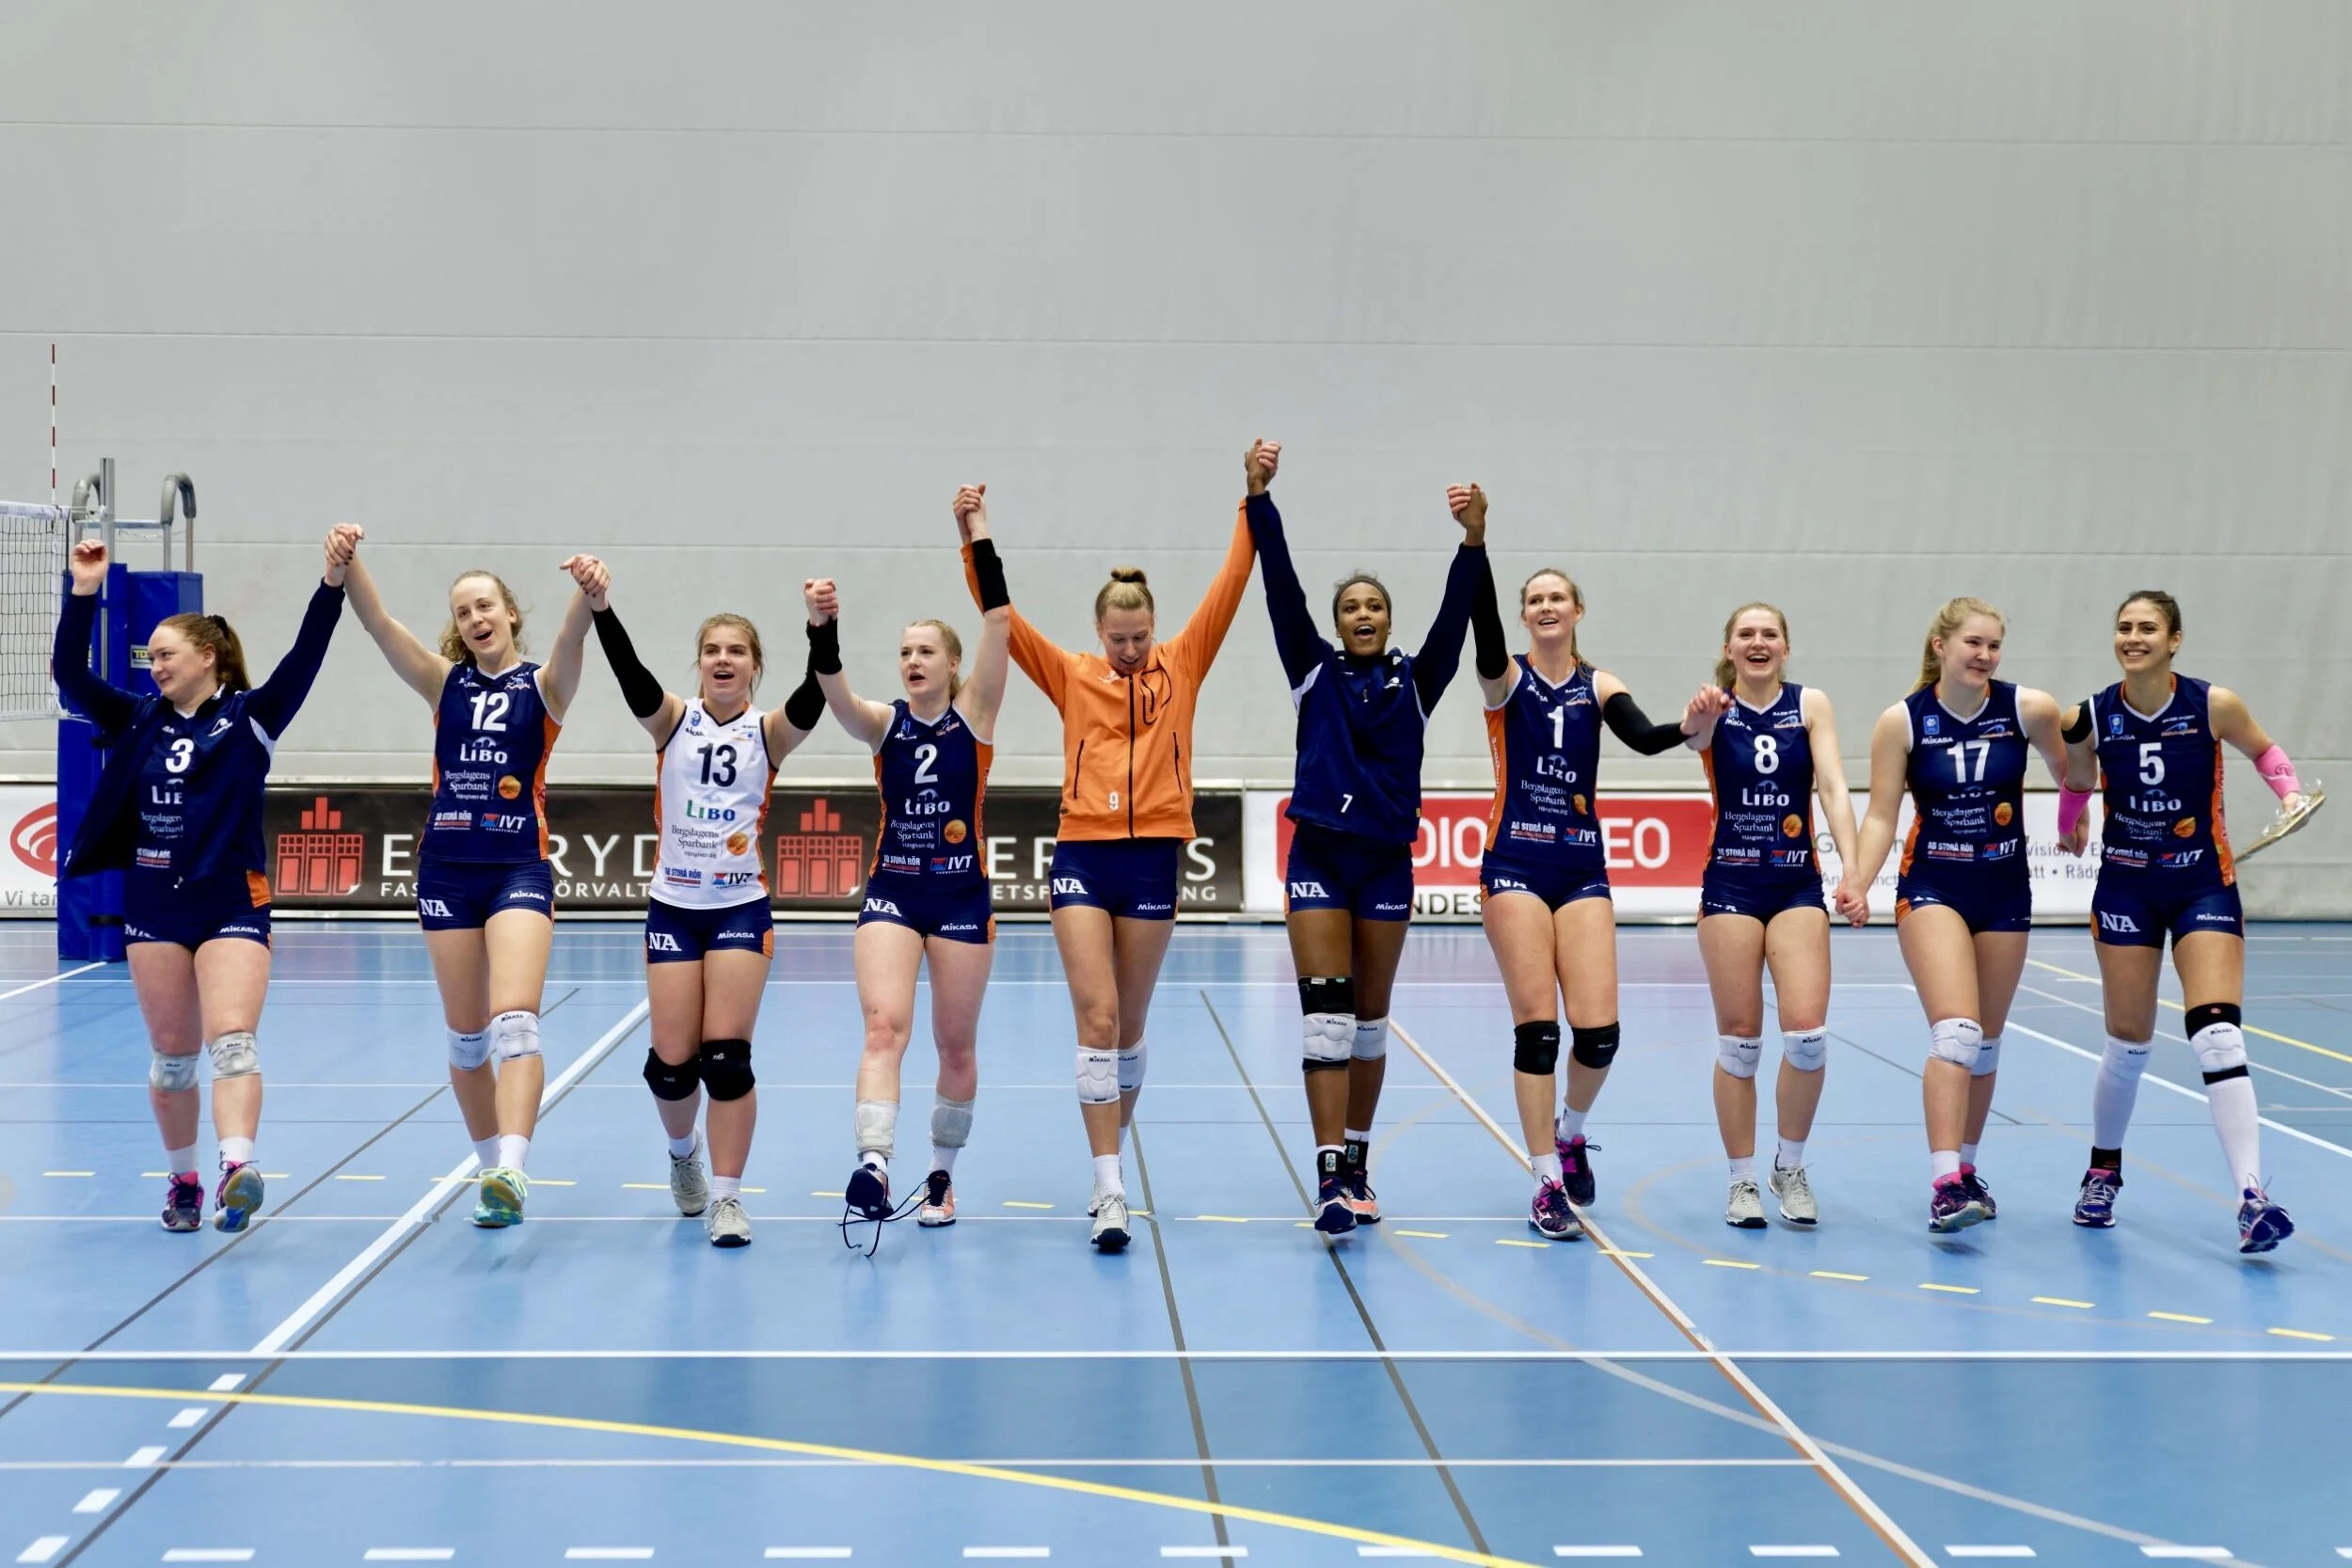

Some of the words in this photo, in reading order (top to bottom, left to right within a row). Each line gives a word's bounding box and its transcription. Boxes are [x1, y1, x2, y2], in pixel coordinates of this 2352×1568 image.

[470, 690, 510, 732] 12
[1547, 705, 1565, 749] 1
[166, 738, 194, 773] 3
[460, 743, 508, 764] LIBO
[1755, 735, 1779, 774] 8
[1947, 740, 1991, 784] 17
[697, 743, 737, 787] 13
[914, 744, 938, 784] 2
[2139, 742, 2165, 785] 5
[450, 781, 489, 793] Sparbank
[1108, 791, 1120, 811] 9
[1341, 794, 1353, 813] 7
[1742, 788, 1789, 807] LIBO
[2130, 795, 2182, 813] LIBO
[686, 800, 736, 821] LIBO
[905, 798, 951, 816] LIBO
[499, 815, 527, 830] IVT
[1724, 811, 1776, 823] Bergslagens
[671, 825, 720, 838] Bergslagens
[1511, 820, 1520, 830] AB
[1521, 822, 1541, 832] STORÅ
[1542, 823, 1556, 834] RÖR
[1732, 821, 1774, 833] Sparbank
[677, 837, 717, 849] Sparbank
[907, 856, 921, 866] RÖR
[1725, 847, 1746, 857] STORÅ
[1747, 847, 1760, 858] RÖR
[1786, 849, 1808, 863] IVT
[2175, 849, 2203, 864] IVT
[948, 854, 974, 870] IVT
[672, 867, 688, 879] STORÅ
[689, 868, 702, 879] RÖR
[1052, 878, 1089, 895] NA
[1291, 881, 1329, 898] NA
[5, 890, 24, 906] Vi
[863, 897, 902, 916] NA
[419, 898, 453, 917] NA
[2100, 911, 2141, 933] NA
[648, 931, 682, 952] NA
